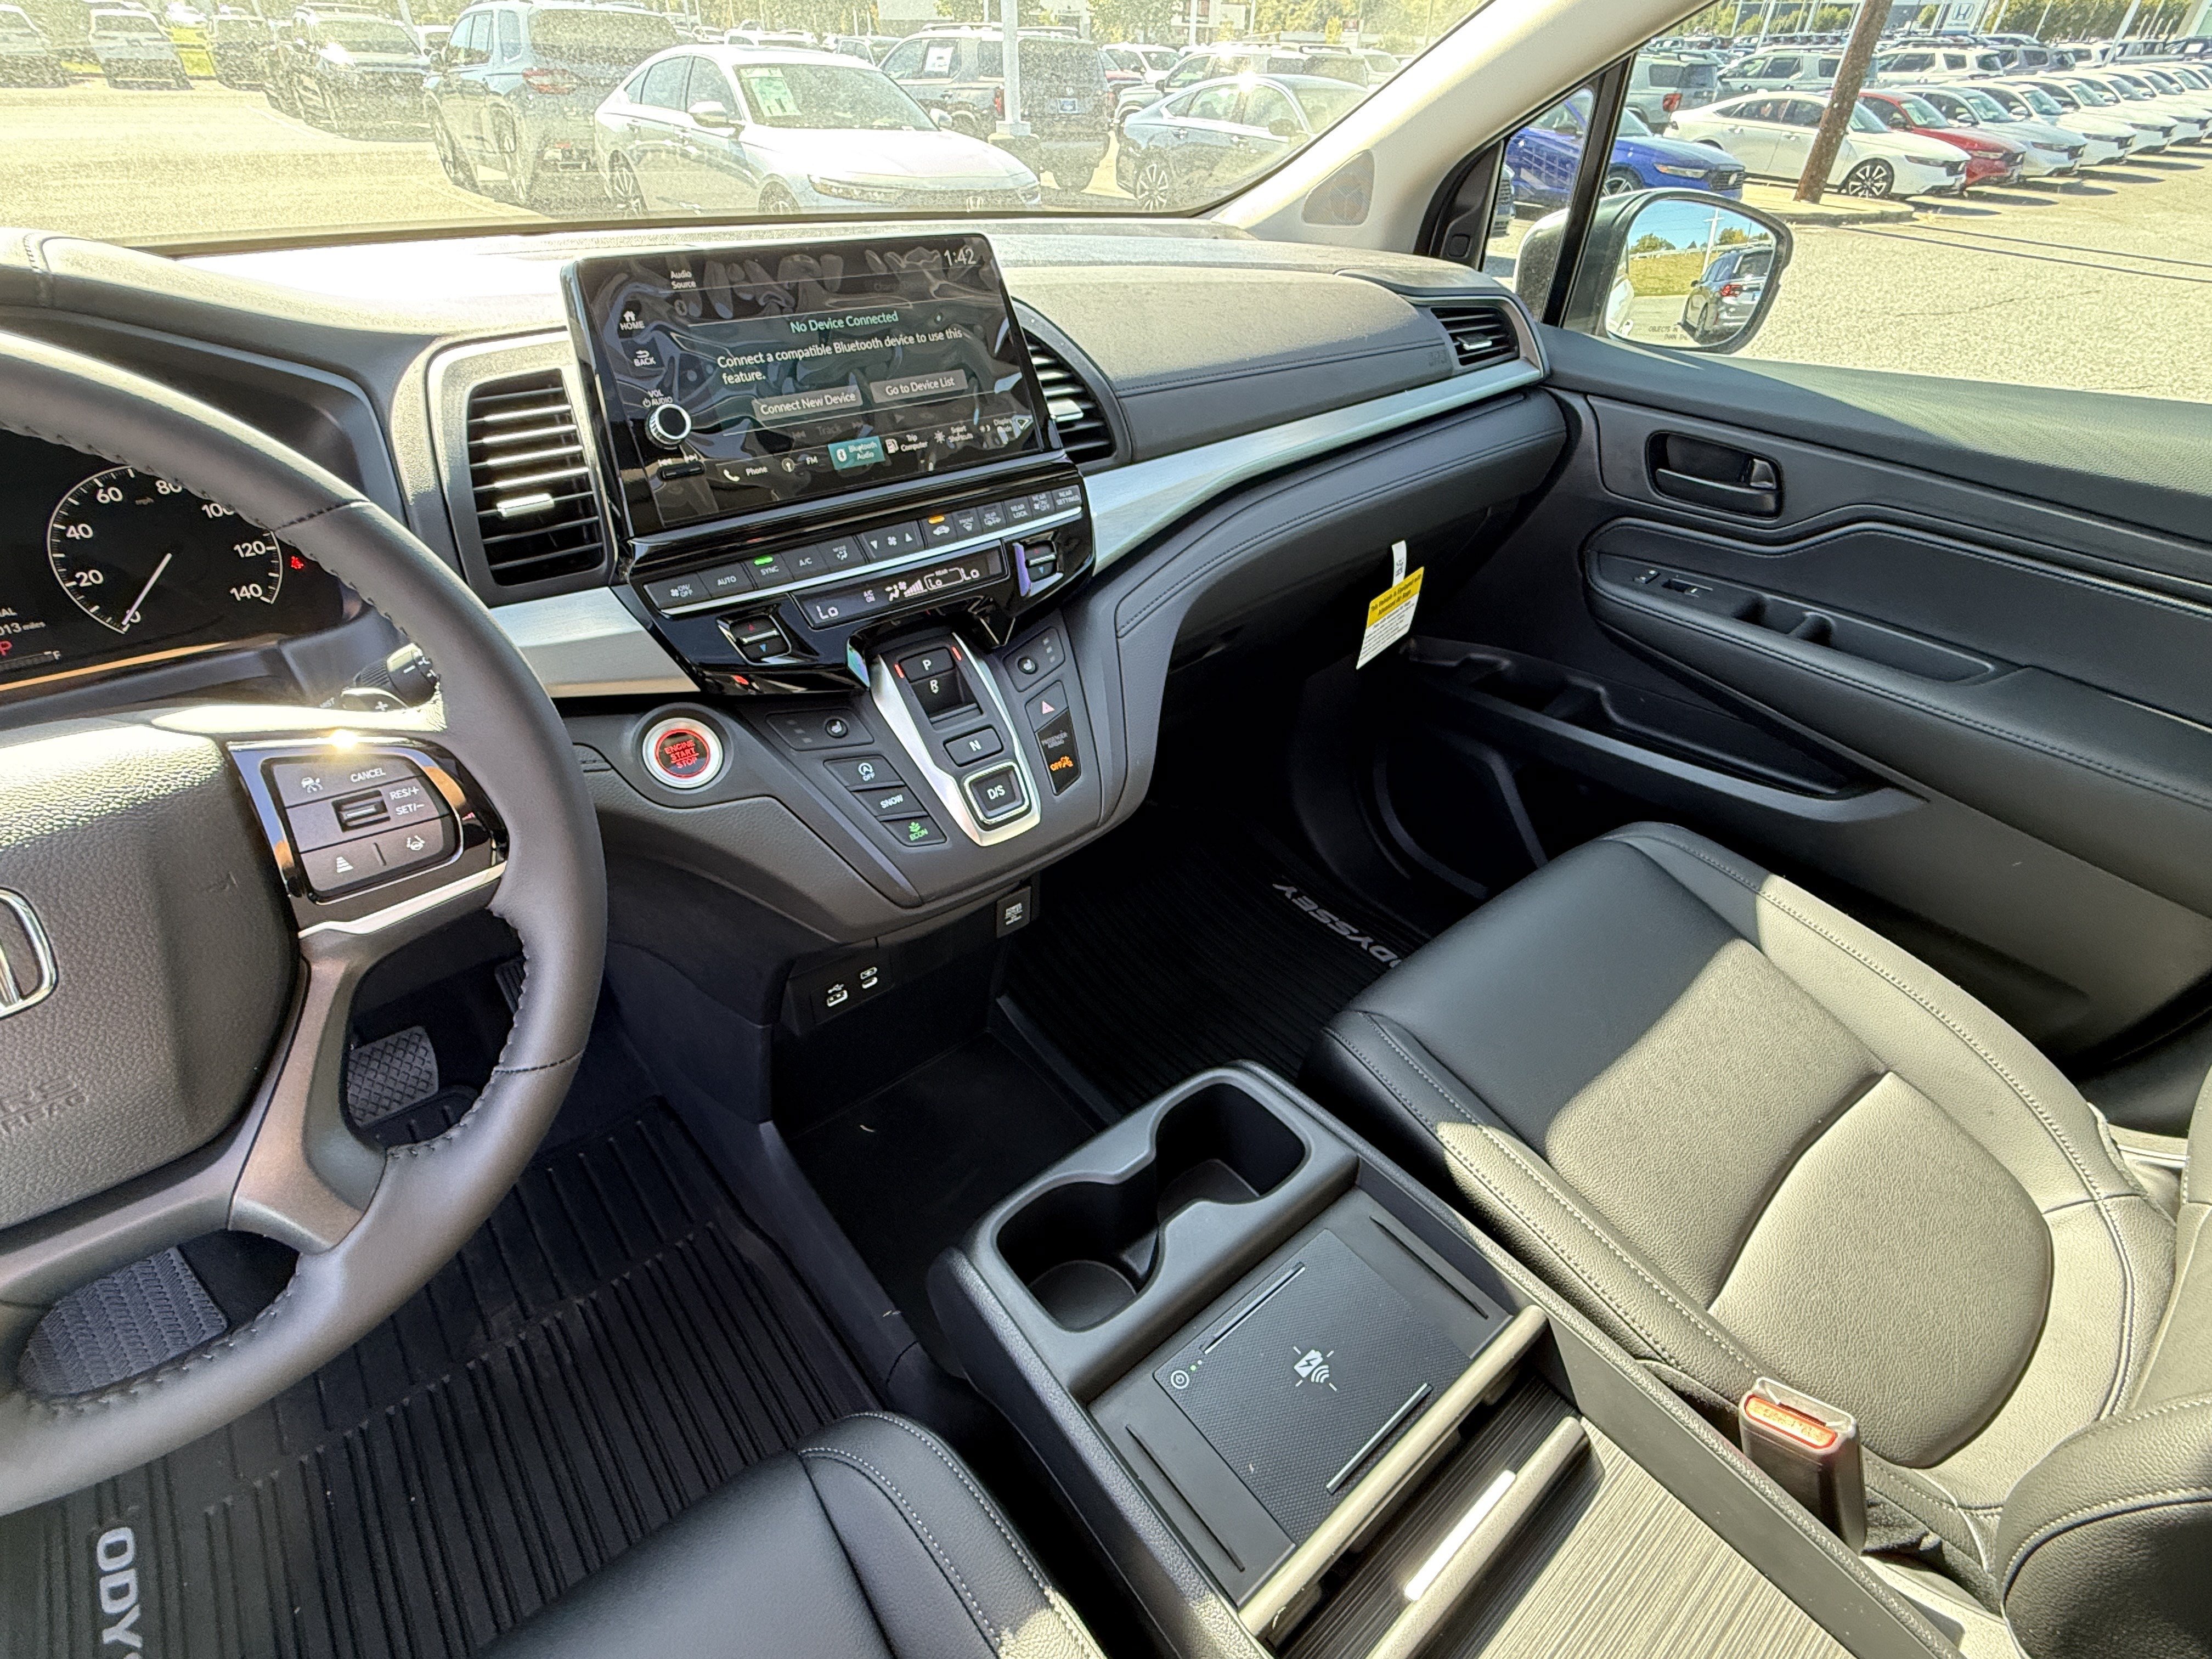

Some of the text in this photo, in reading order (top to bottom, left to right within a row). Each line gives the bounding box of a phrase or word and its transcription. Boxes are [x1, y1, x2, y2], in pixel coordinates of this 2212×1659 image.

[944, 249, 977, 266] 1:42
[670, 270, 692, 279] Audio
[671, 281, 696, 289] Source
[619, 320, 645, 330] HOME
[790, 311, 899, 333] No Device Connected
[718, 328, 962, 368] Connect a compatible Bluetooth device to use this
[634, 357, 656, 366] BACK
[723, 371, 766, 385] feature.
[885, 377, 955, 396] Go to Device List
[647, 389, 664, 398] VOL
[651, 396, 673, 406] AUDIO
[760, 392, 856, 414] Connect New Device
[848, 441, 877, 453] Bluetooth
[806, 456, 818, 465] FM
[857, 451, 874, 460] Audio
[746, 467, 768, 476] Phone
[96, 487, 123, 504] 60
[66, 523, 94, 540] 40
[233, 540, 266, 558] 120
[799, 557, 812, 567] A/C
[760, 566, 780, 575] SYNC
[960, 567, 980, 580] Lo
[75, 569, 104, 587] 20
[717, 575, 737, 586] AUTO
[928, 579, 943, 588] Lo
[230, 583, 263, 601] 140
[680, 589, 693, 597] OFF
[816, 605, 839, 619] Lo
[53, 651, 61, 660] F
[922, 659, 932, 671] P
[930, 680, 939, 690] R
[664, 739, 696, 754] ENGINE
[969, 740, 982, 752] N
[670, 747, 696, 760] START
[676, 757, 697, 768] STOP
[1050, 761, 1062, 771] OFF
[350, 768, 386, 782] CANCEL
[862, 772, 875, 781] OFF
[389, 786, 419, 800] RES/+
[987, 785, 1006, 800] D/S
[880, 794, 903, 809] SNOW
[909, 828, 928, 841] ECON
